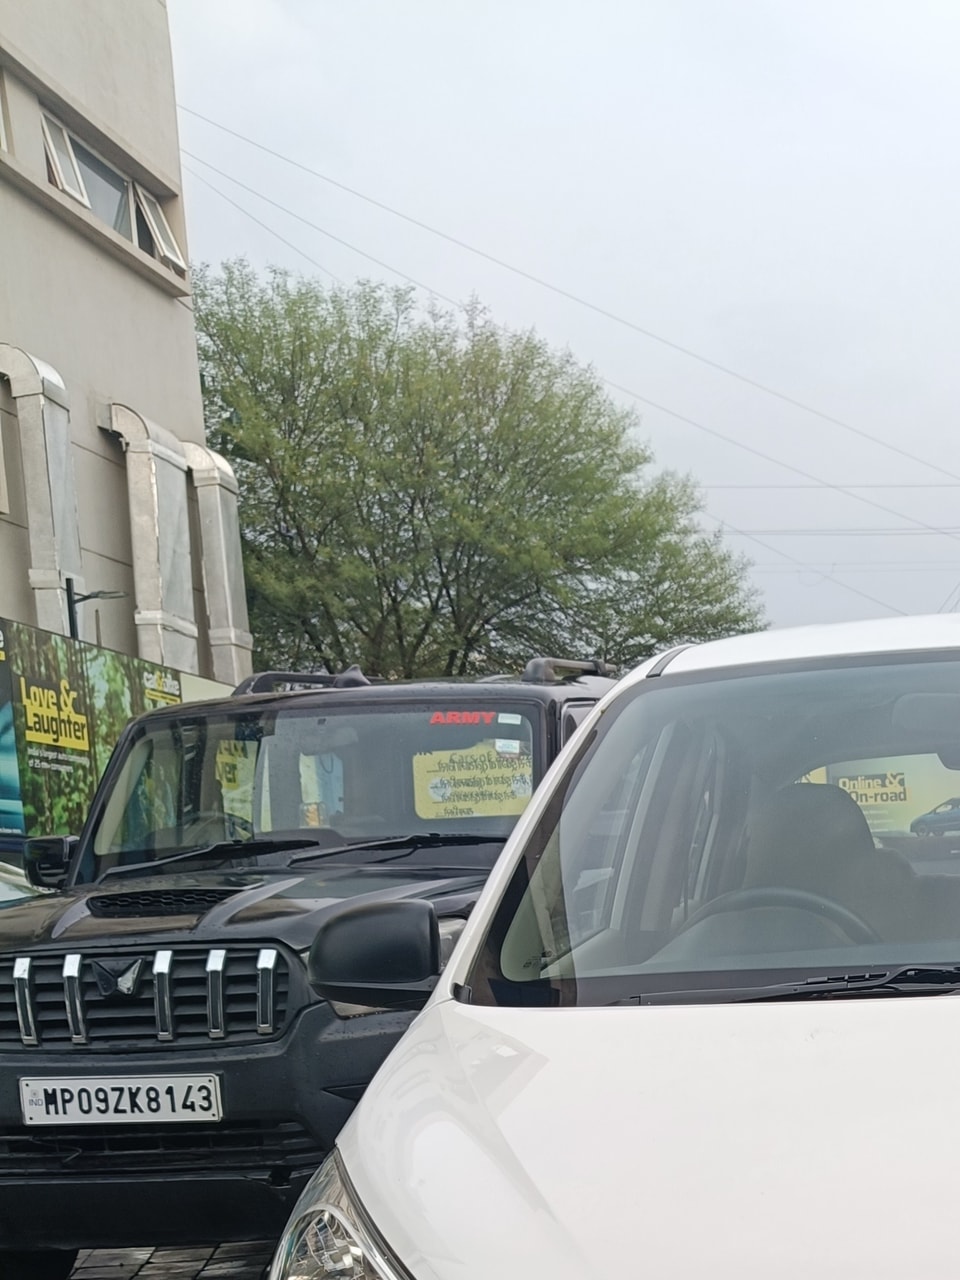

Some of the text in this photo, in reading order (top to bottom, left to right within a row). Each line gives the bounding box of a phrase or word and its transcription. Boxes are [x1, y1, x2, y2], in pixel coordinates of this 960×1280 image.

[20, 677, 77, 714] Love &
[26, 707, 86, 742] Laughter
[430, 711, 496, 725] ARMY
[838, 771, 905, 790] Online &
[849, 787, 907, 803] On-road
[29, 1085, 212, 1115] IND MP09ZK8143
